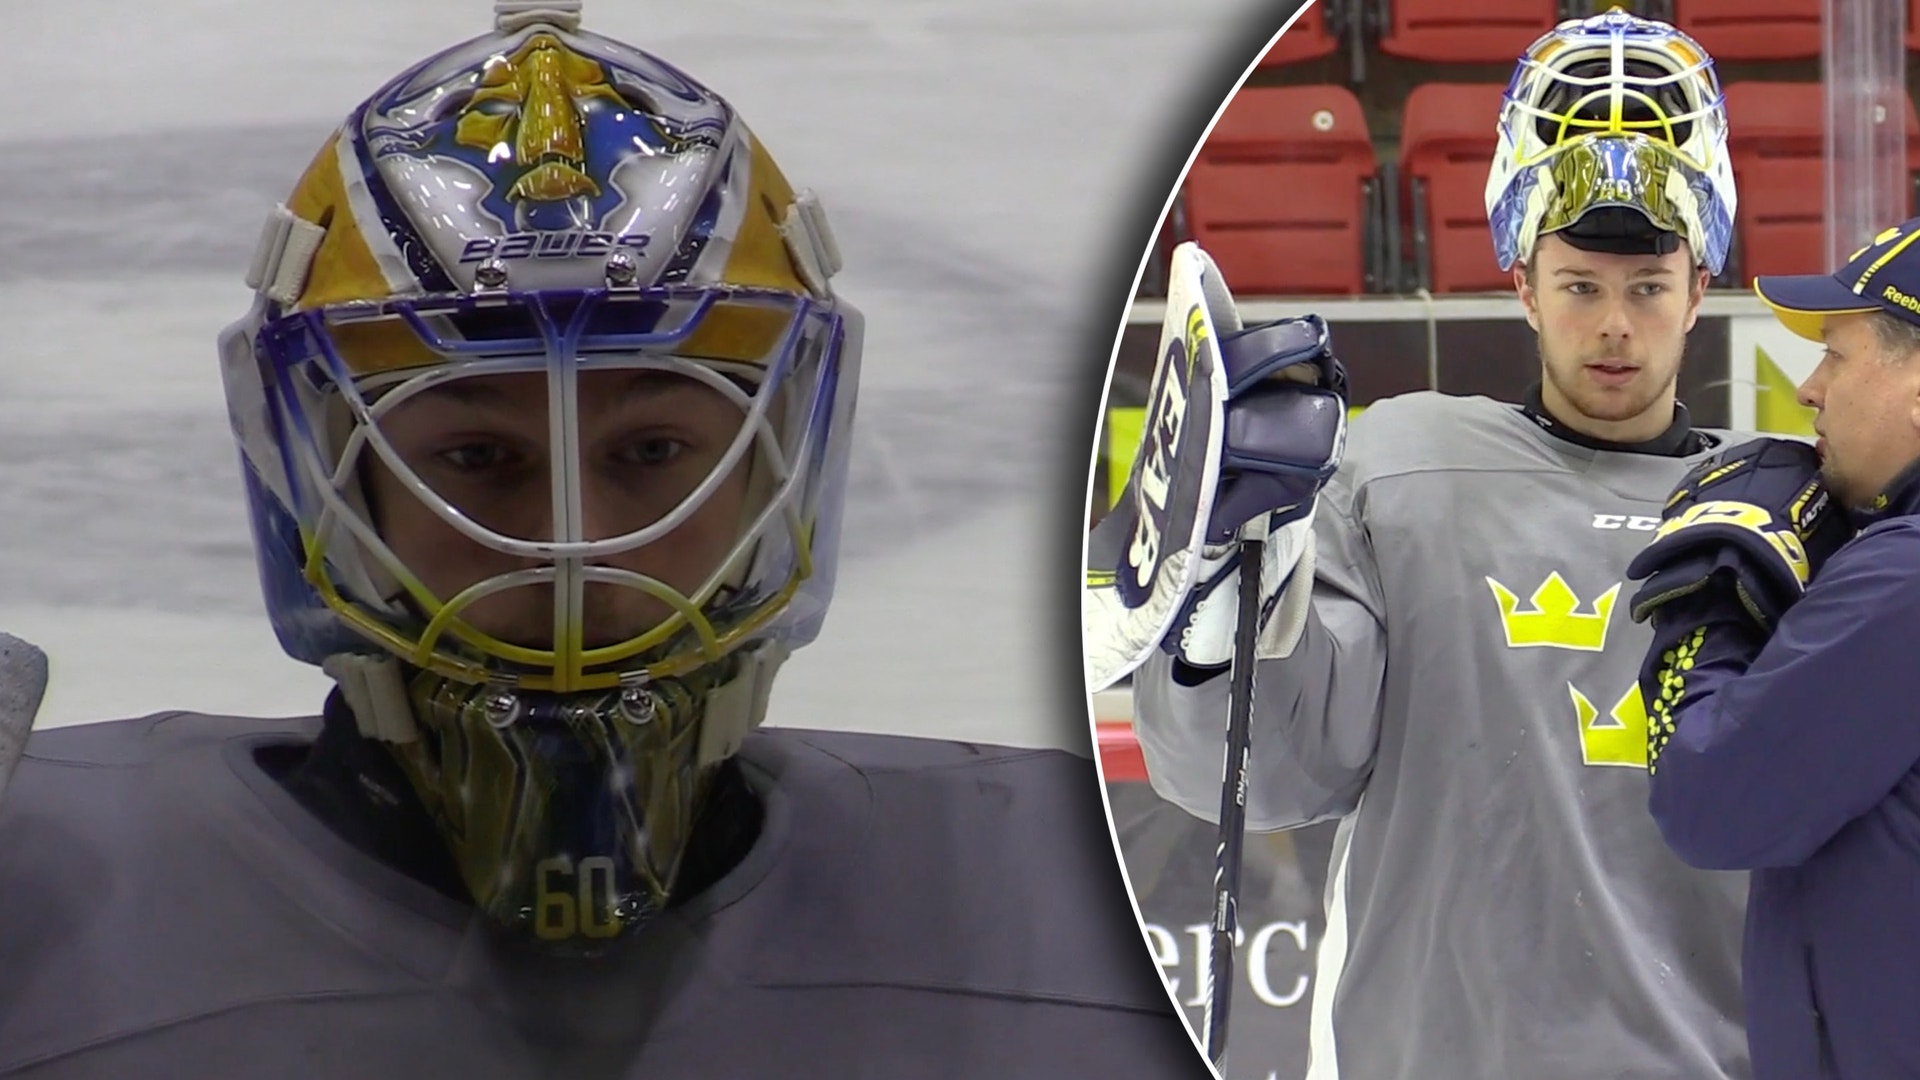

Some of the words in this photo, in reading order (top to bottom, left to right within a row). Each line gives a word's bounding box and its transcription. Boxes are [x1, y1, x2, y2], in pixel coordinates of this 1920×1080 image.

[459, 231, 651, 263] BAUER
[1592, 514, 1661, 532] CC
[535, 856, 622, 940] 60
[1144, 921, 1320, 1007] erc
